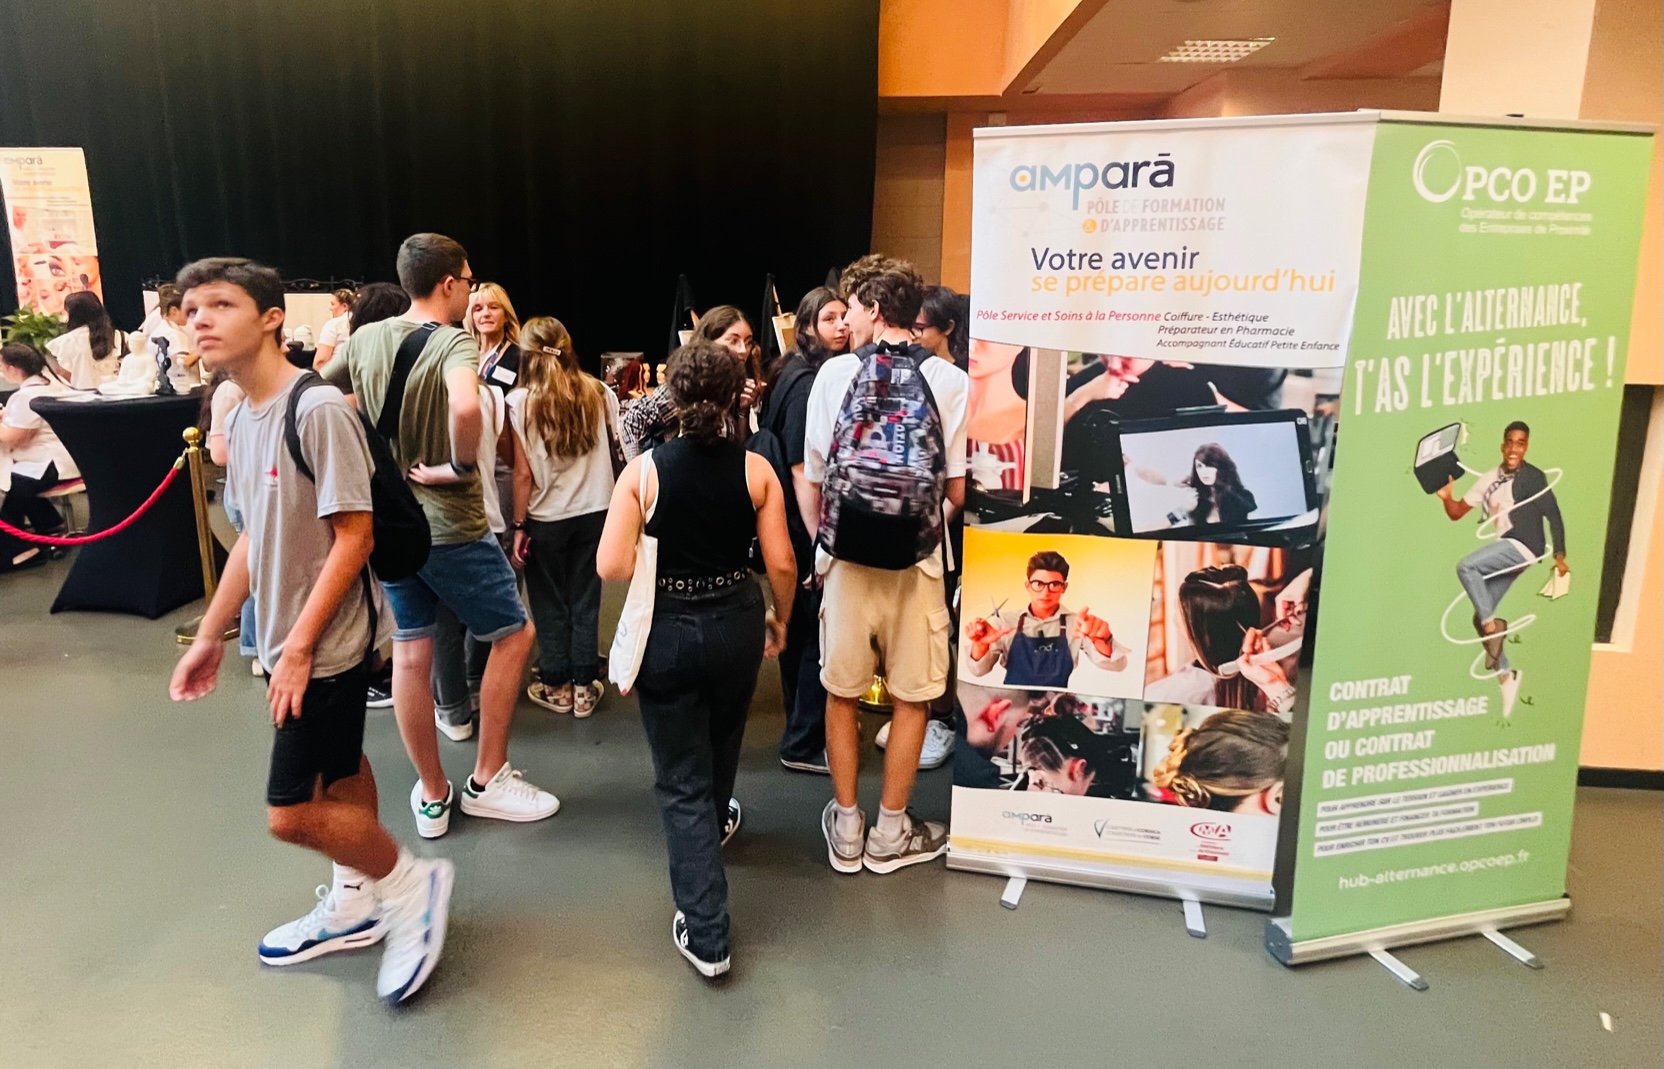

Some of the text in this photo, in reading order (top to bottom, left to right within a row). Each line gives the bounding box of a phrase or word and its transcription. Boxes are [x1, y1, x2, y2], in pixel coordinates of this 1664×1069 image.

[1413, 139, 1591, 204] OPCO EP
[1087, 196, 1119, 214] PÔLE
[1142, 197, 1226, 214] FORMATION
[1100, 216, 1225, 233] D'APPRENTISSAGE
[1031, 246, 1199, 271] Votre avenir
[1031, 268, 1335, 297] se prépare aujourd'hui
[976, 310, 1162, 322] Pôle Service et Soins à la Personne
[1163, 312, 1204, 322] Coiffure
[1212, 312, 1269, 324] Esthétique
[1387, 282, 1587, 340] AVEC L'ALTERNANCE,
[1156, 338, 1340, 351] Accompagnant Éducatif Petite Enfance
[1157, 325, 1296, 337] Préparateur en Pharmacie
[1354, 355, 1411, 416] T'AS
[1420, 337, 1598, 410] L'EXPÉRIENCE
[1329, 675, 1412, 701] CONTRAT
[1327, 696, 1489, 731] D'APPRENTISSAGE
[1324, 730, 1436, 760] OU CONTRAT
[1322, 743, 1556, 789] DE PROFESSIONNALISATION
[1338, 849, 1530, 889] hub-alternance.opcoep.fr
